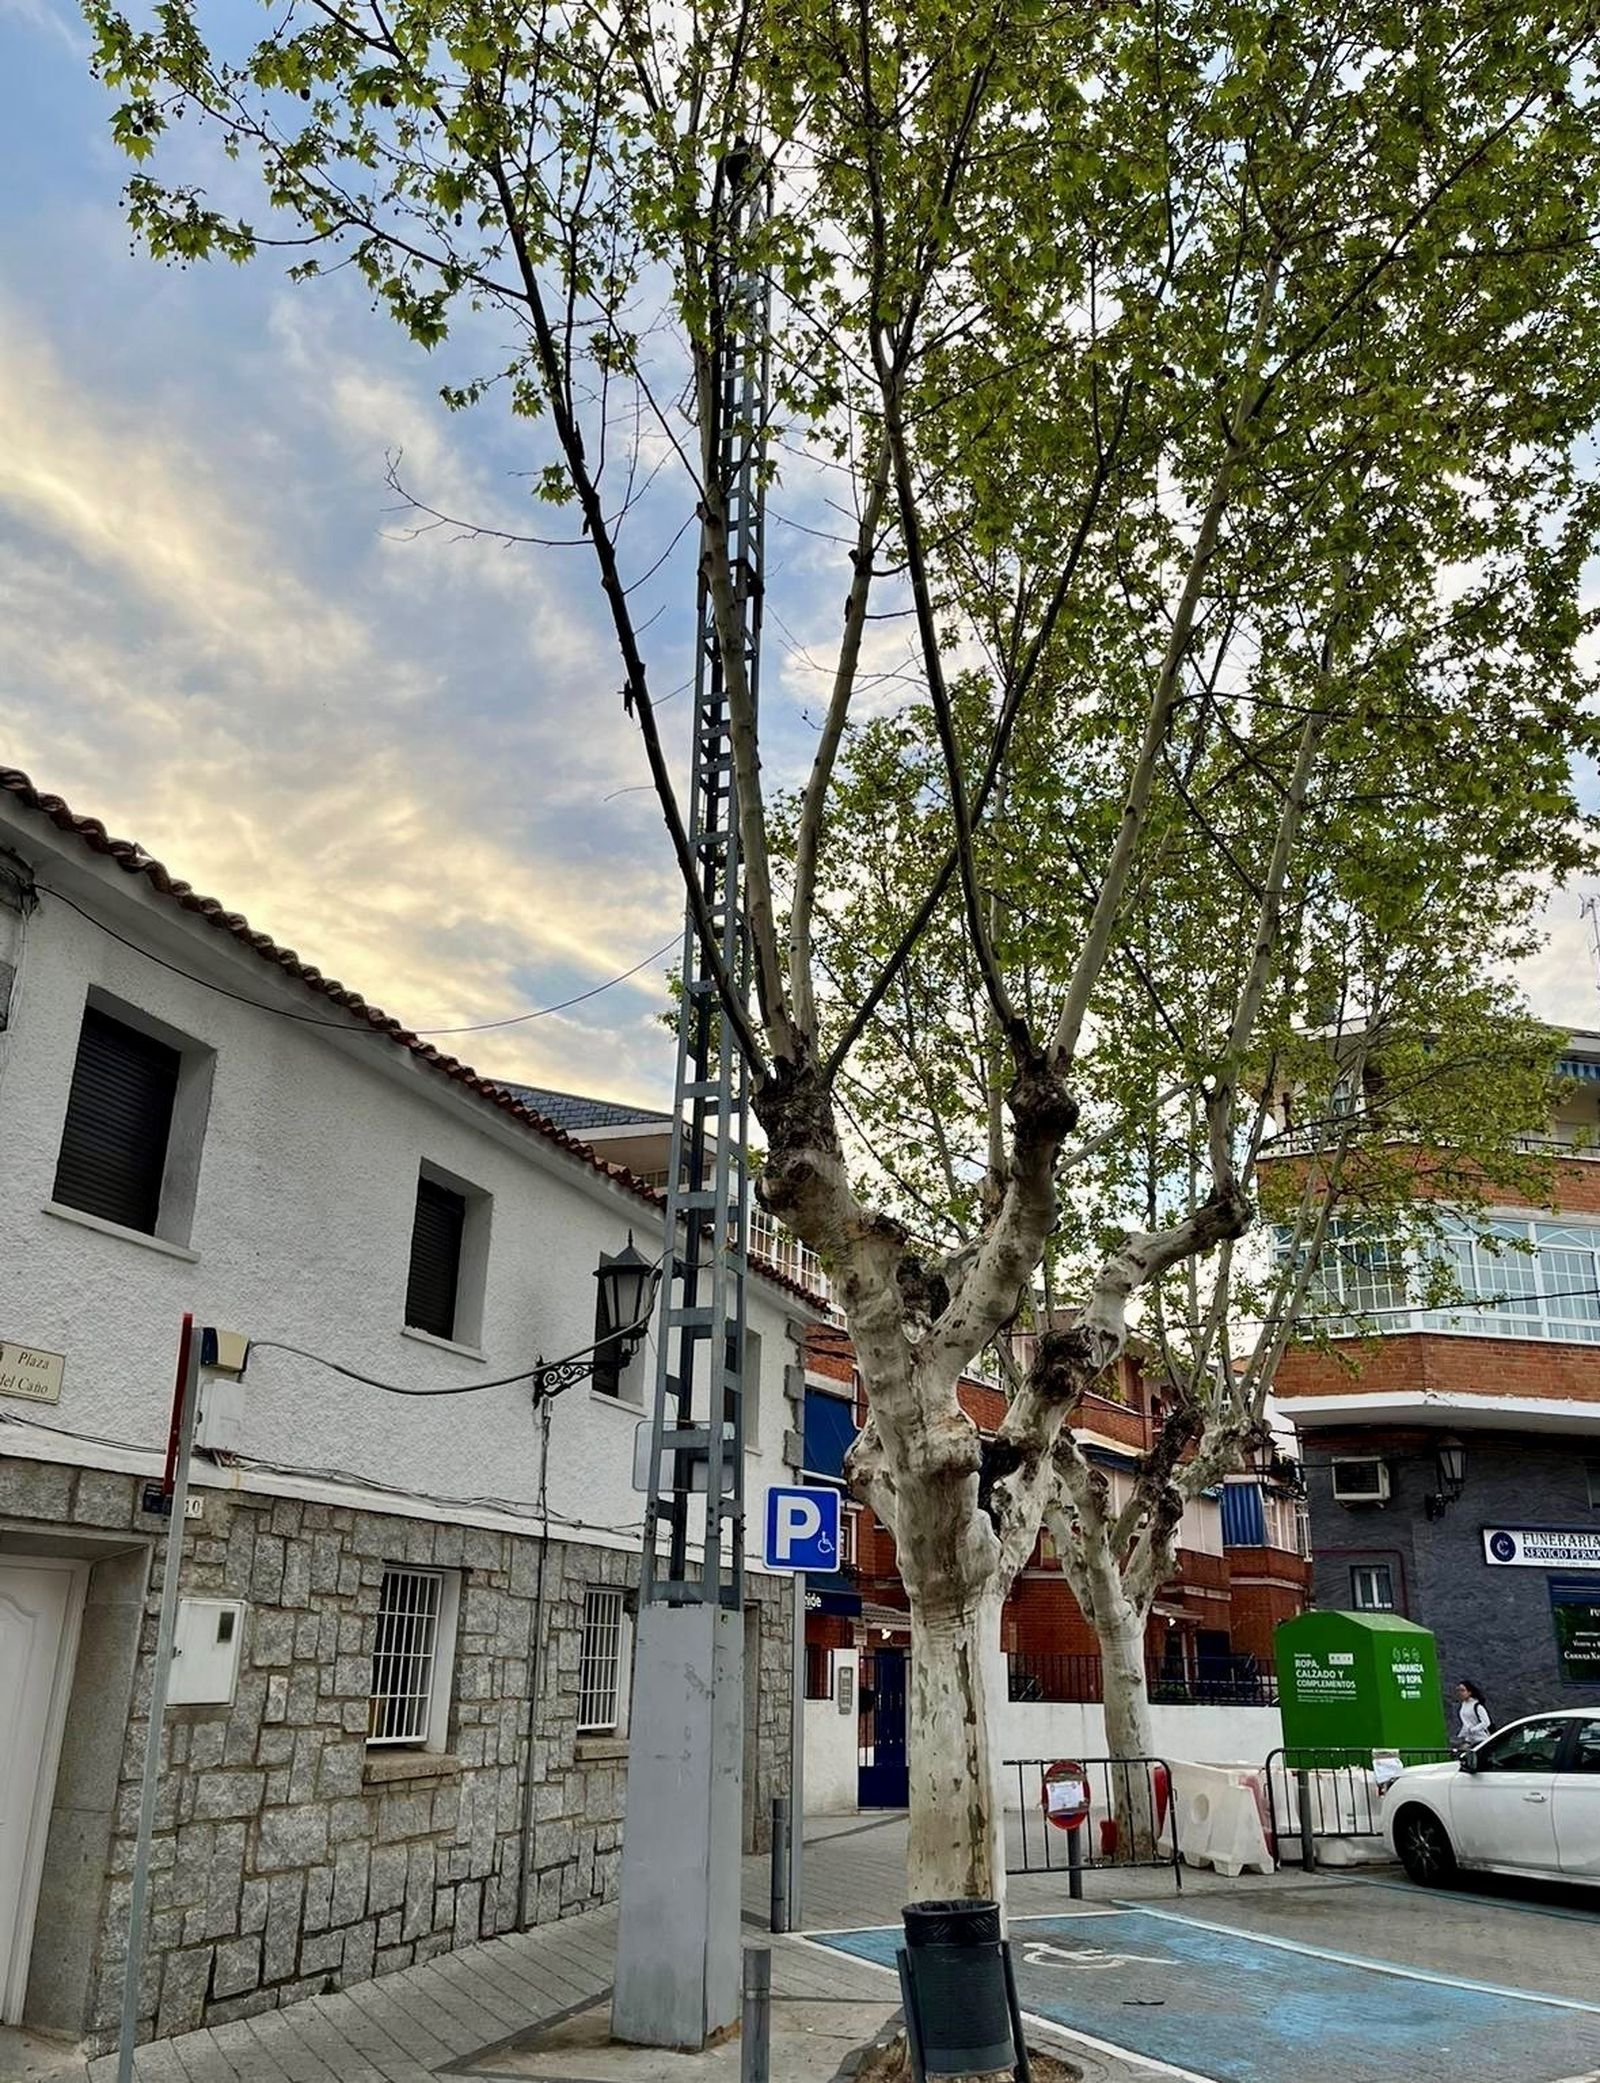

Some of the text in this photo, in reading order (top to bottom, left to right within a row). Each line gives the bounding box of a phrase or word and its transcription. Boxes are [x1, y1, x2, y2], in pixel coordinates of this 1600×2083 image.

[18, 1351, 50, 1369] Plaza
[775, 1495, 821, 1559] P
[1524, 1547, 1568, 1559] SERVICIO
[1295, 1669, 1344, 1679] CALZADO Y
[1296, 1679, 1356, 1689] COMPLEMENTOS
